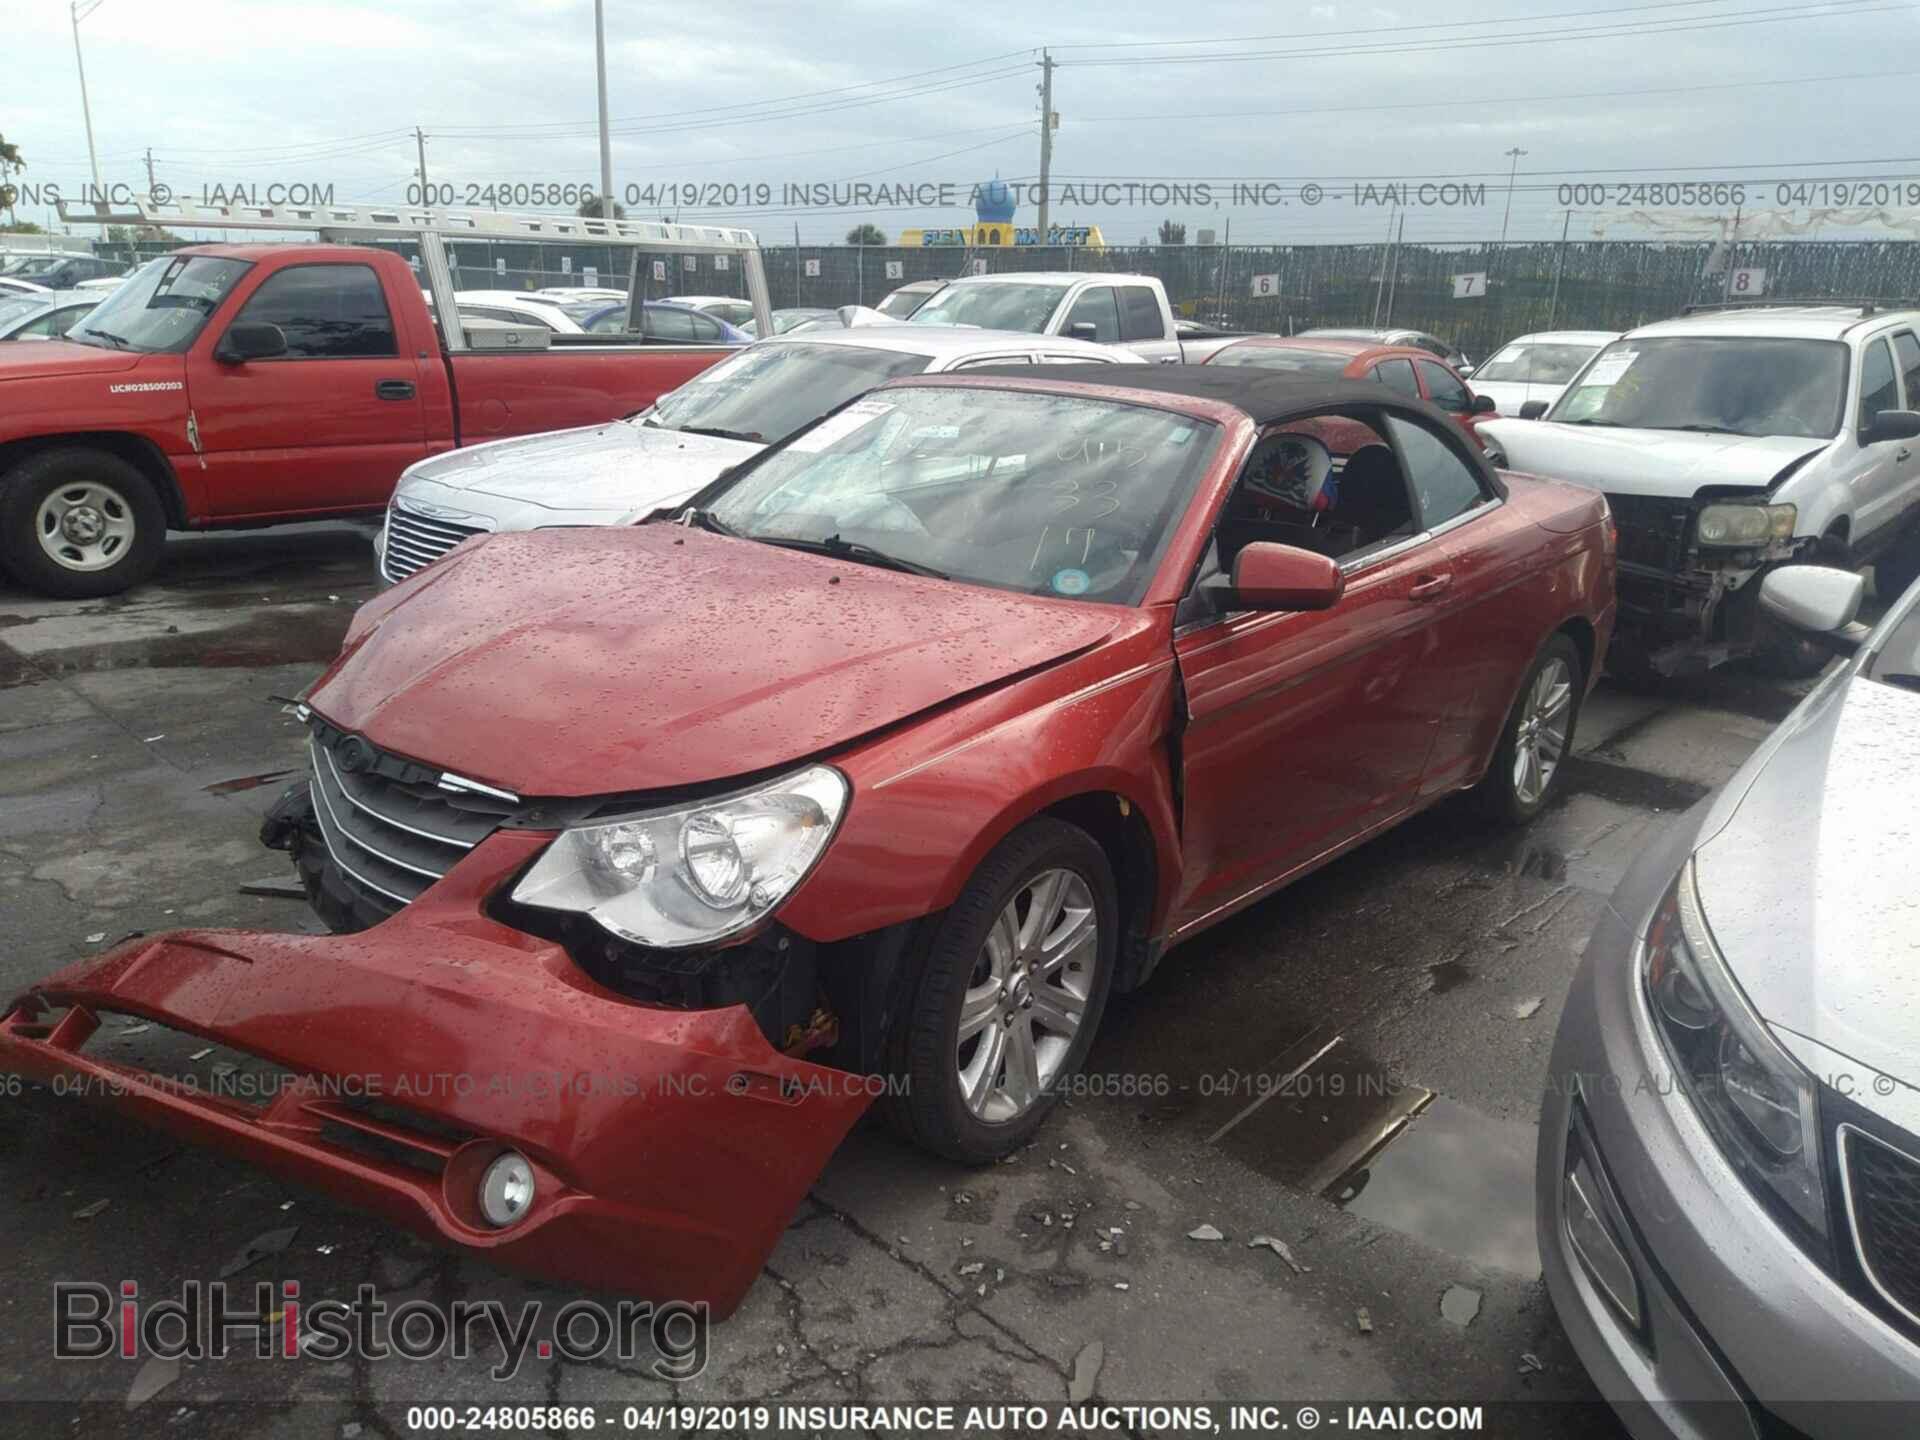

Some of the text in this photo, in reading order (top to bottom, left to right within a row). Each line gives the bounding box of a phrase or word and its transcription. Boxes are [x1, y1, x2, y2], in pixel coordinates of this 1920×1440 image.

[922, 227, 1090, 247] FLEA MAKET
[889, 259, 897, 276] 3
[1260, 277, 1270, 293] 6
[1463, 277, 1474, 294] 7
[1736, 272, 1750, 291] 8
